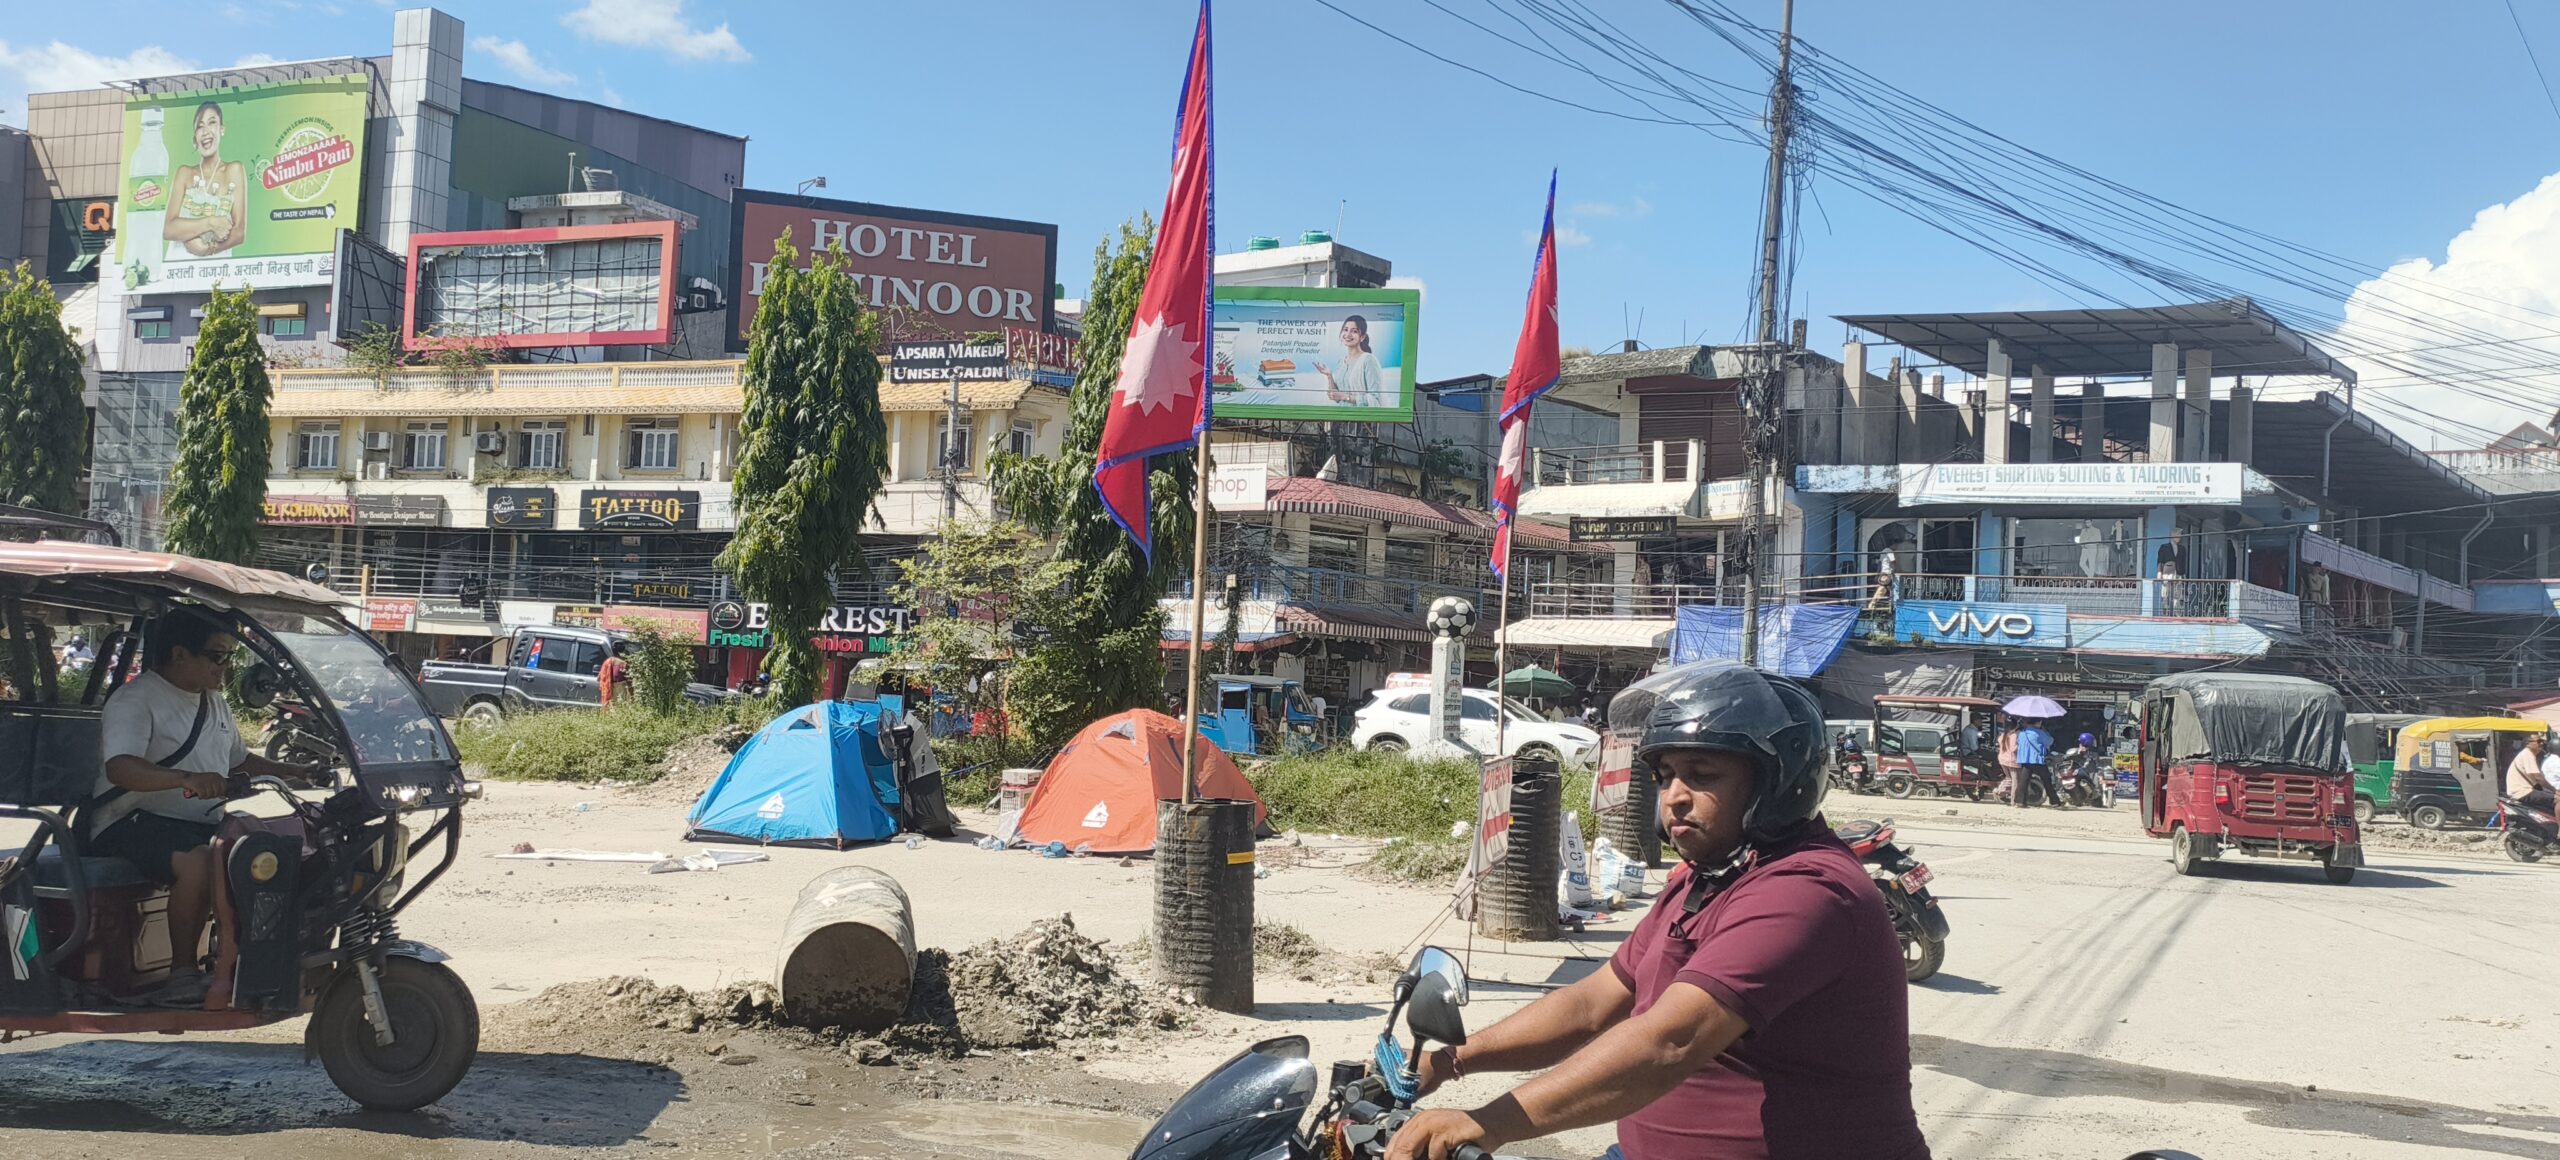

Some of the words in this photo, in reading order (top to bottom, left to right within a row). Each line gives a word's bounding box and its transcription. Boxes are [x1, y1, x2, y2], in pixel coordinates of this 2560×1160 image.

[266, 158, 314, 185] Nimbu
[317, 142, 351, 168] Pani
[273, 210, 282, 218] THE
[283, 209, 298, 218] TASTE
[299, 209, 306, 217] OF
[307, 208, 324, 217] NEPAL
[810, 218, 988, 269] HOTEL
[166, 266, 194, 280] असली
[234, 262, 263, 276] असली
[293, 259, 313, 273] पानी
[1258, 319, 1273, 327] THE
[1275, 319, 1305, 327] POWER
[1257, 327, 1293, 335] PERFECT
[1261, 347, 1294, 355] Detergent
[1296, 347, 1320, 355] Powder
[1262, 339, 1291, 348] Patanjali
[1293, 340, 1319, 348] Popular
[894, 345, 944, 360] APSARA
[948, 343, 1005, 359] MAKEUP
[893, 366, 948, 380] UNISEX
[1938, 465, 1990, 483] EVEREST
[1995, 465, 2055, 483] SHIRTING
[2058, 465, 2111, 483] SUITING
[2115, 466, 2126, 483] &
[2131, 465, 2201, 484] TAILORING
[280, 502, 350, 518] KOHINOOR
[359, 510, 368, 519] The
[370, 510, 393, 521] Boutique
[394, 511, 418, 521] Designer
[419, 511, 436, 520] House
[591, 496, 685, 522] TATTOO
[1614, 520, 1664, 532] CREATION
[633, 582, 691, 599] TATTOO
[572, 606, 590, 614] ELITE
[1927, 606, 2033, 635] vivo
[709, 630, 765, 648] Fresh
[2037, 671, 2081, 682] STORE
